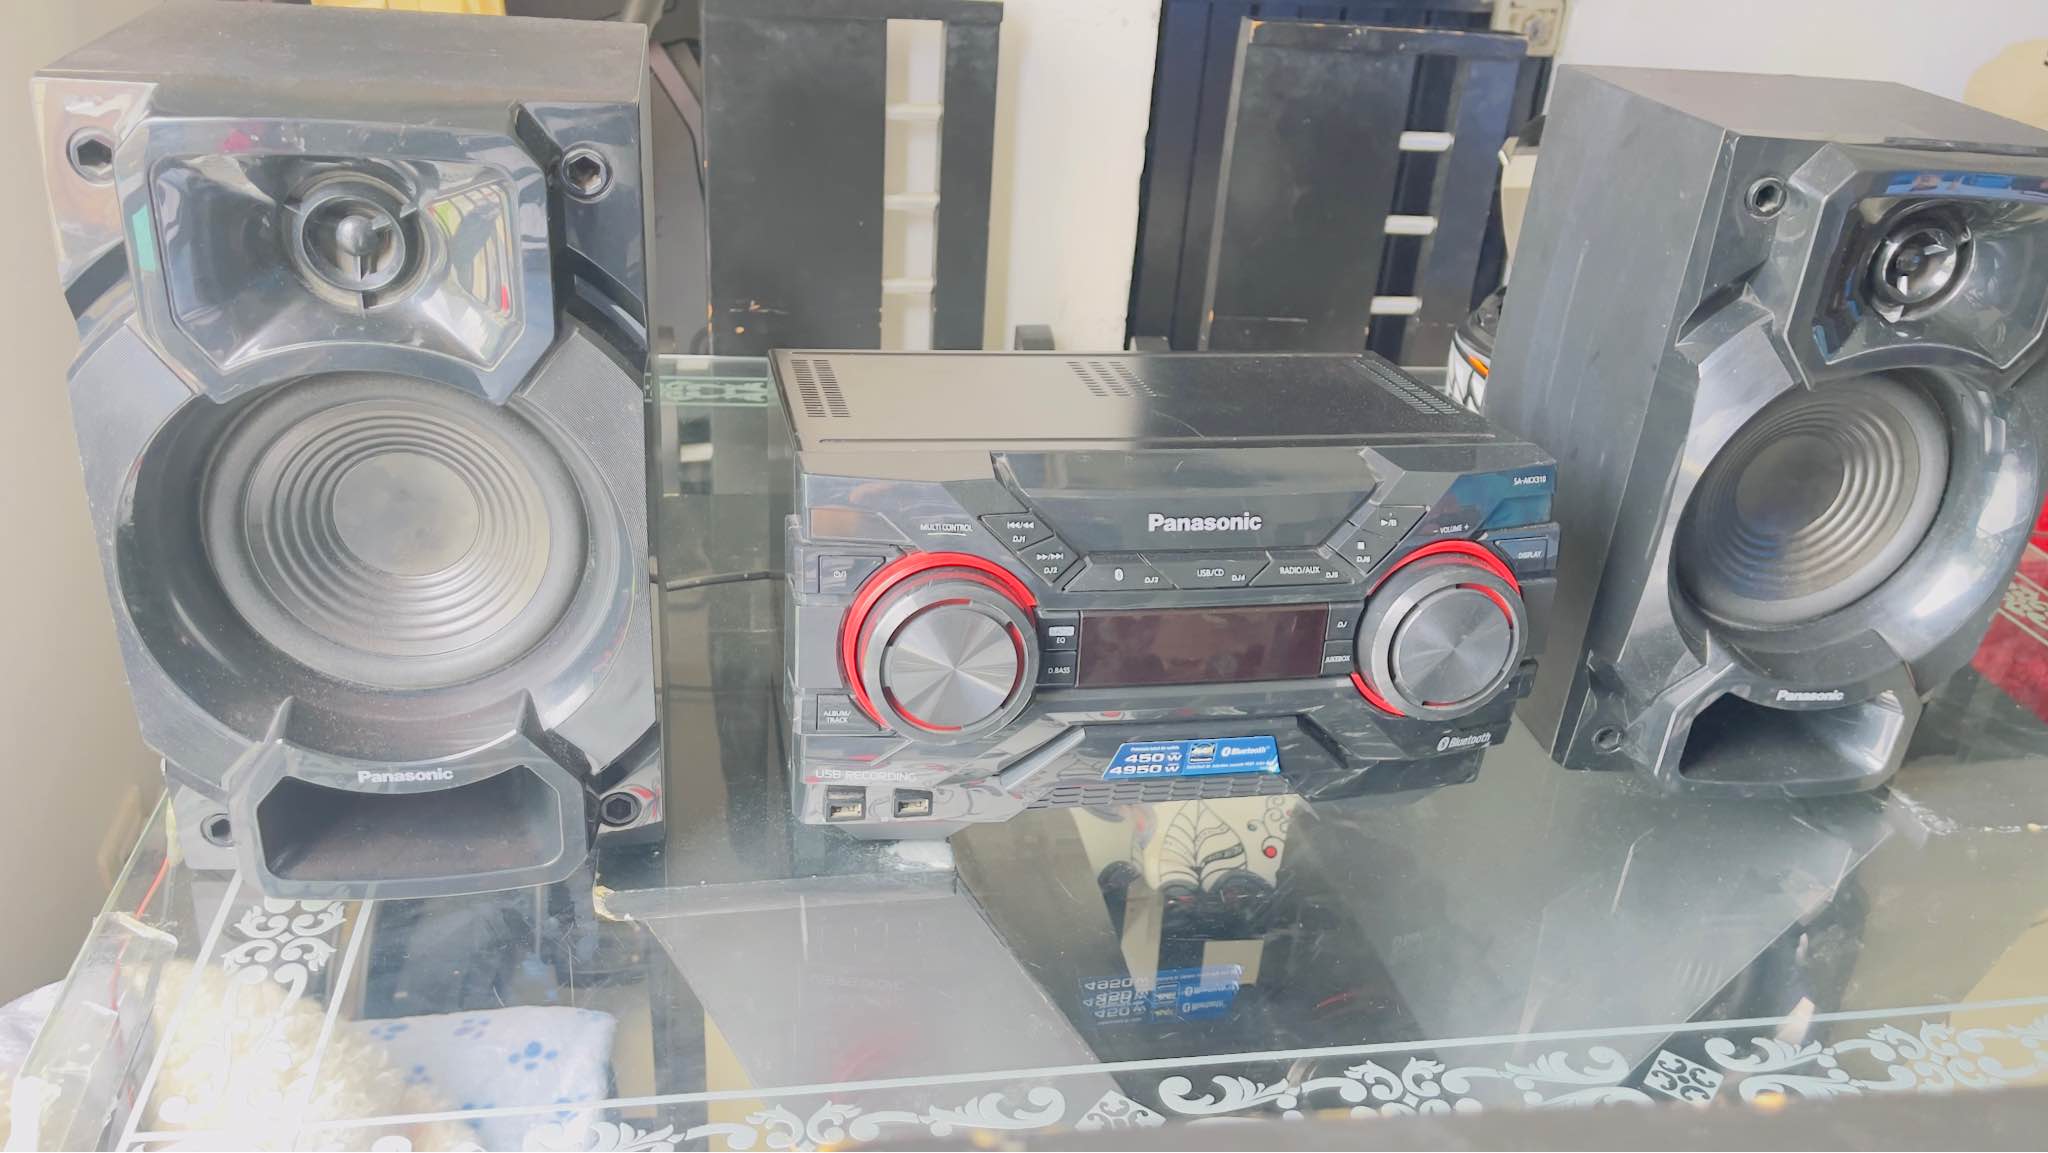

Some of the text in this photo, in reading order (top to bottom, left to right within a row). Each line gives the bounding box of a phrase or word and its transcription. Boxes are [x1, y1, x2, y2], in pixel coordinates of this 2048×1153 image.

[1148, 511, 1263, 532] Panasonic
[920, 523, 973, 532] MULTI CONTROL
[1440, 524, 1462, 534] VOLUME
[1518, 551, 1543, 560] DISPLAY
[1197, 568, 1225, 577] USB/CD
[1279, 566, 1321, 575] RADIO/AUX
[1775, 689, 1845, 701] Panasonic
[827, 716, 849, 724] TRACK
[1448, 731, 1492, 748] Bluetooth
[1124, 753, 1165, 763] 450
[1109, 764, 1163, 775] 4950
[357, 767, 454, 784] Panasonic
[815, 768, 917, 782] USB RECORDING
